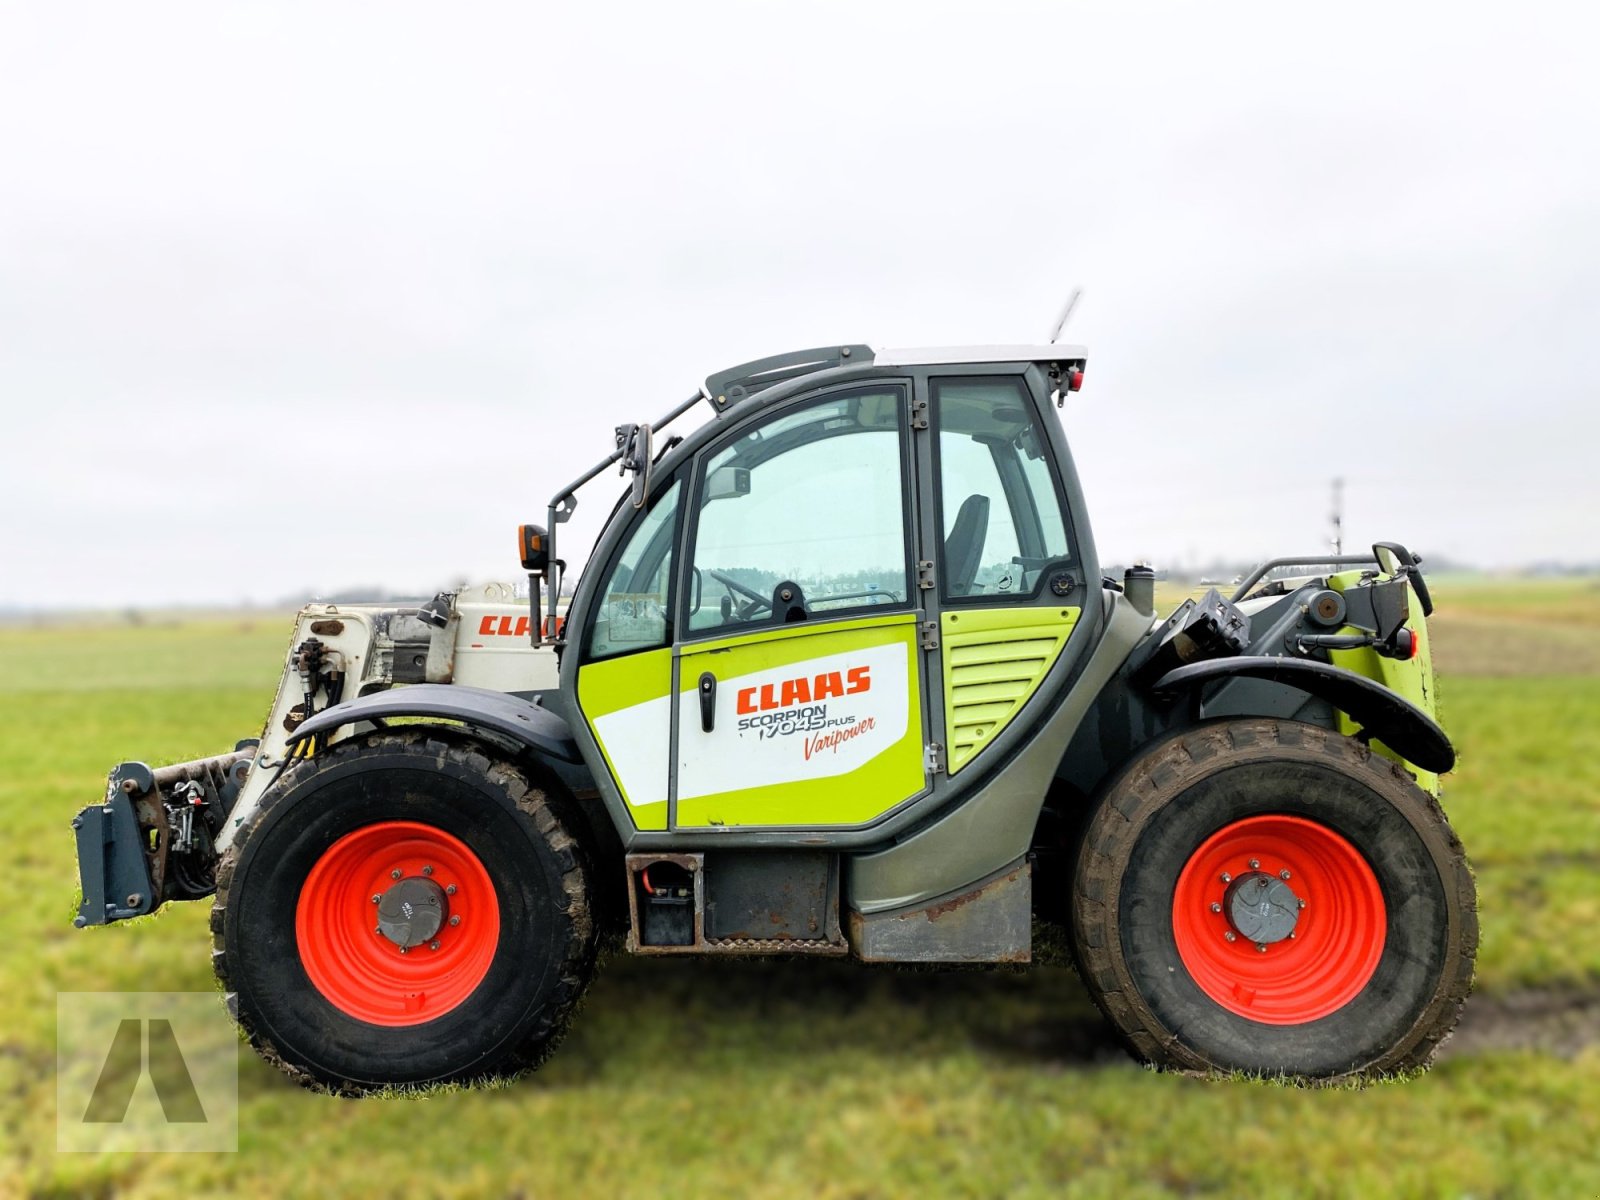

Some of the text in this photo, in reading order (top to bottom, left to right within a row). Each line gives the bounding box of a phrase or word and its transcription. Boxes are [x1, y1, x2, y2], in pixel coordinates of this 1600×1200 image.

[478, 615, 567, 637] CLA
[736, 665, 871, 715] CLAAS
[738, 704, 827, 731] SCORPION
[827, 715, 856, 728] PLUS
[804, 716, 877, 761] Varipower
